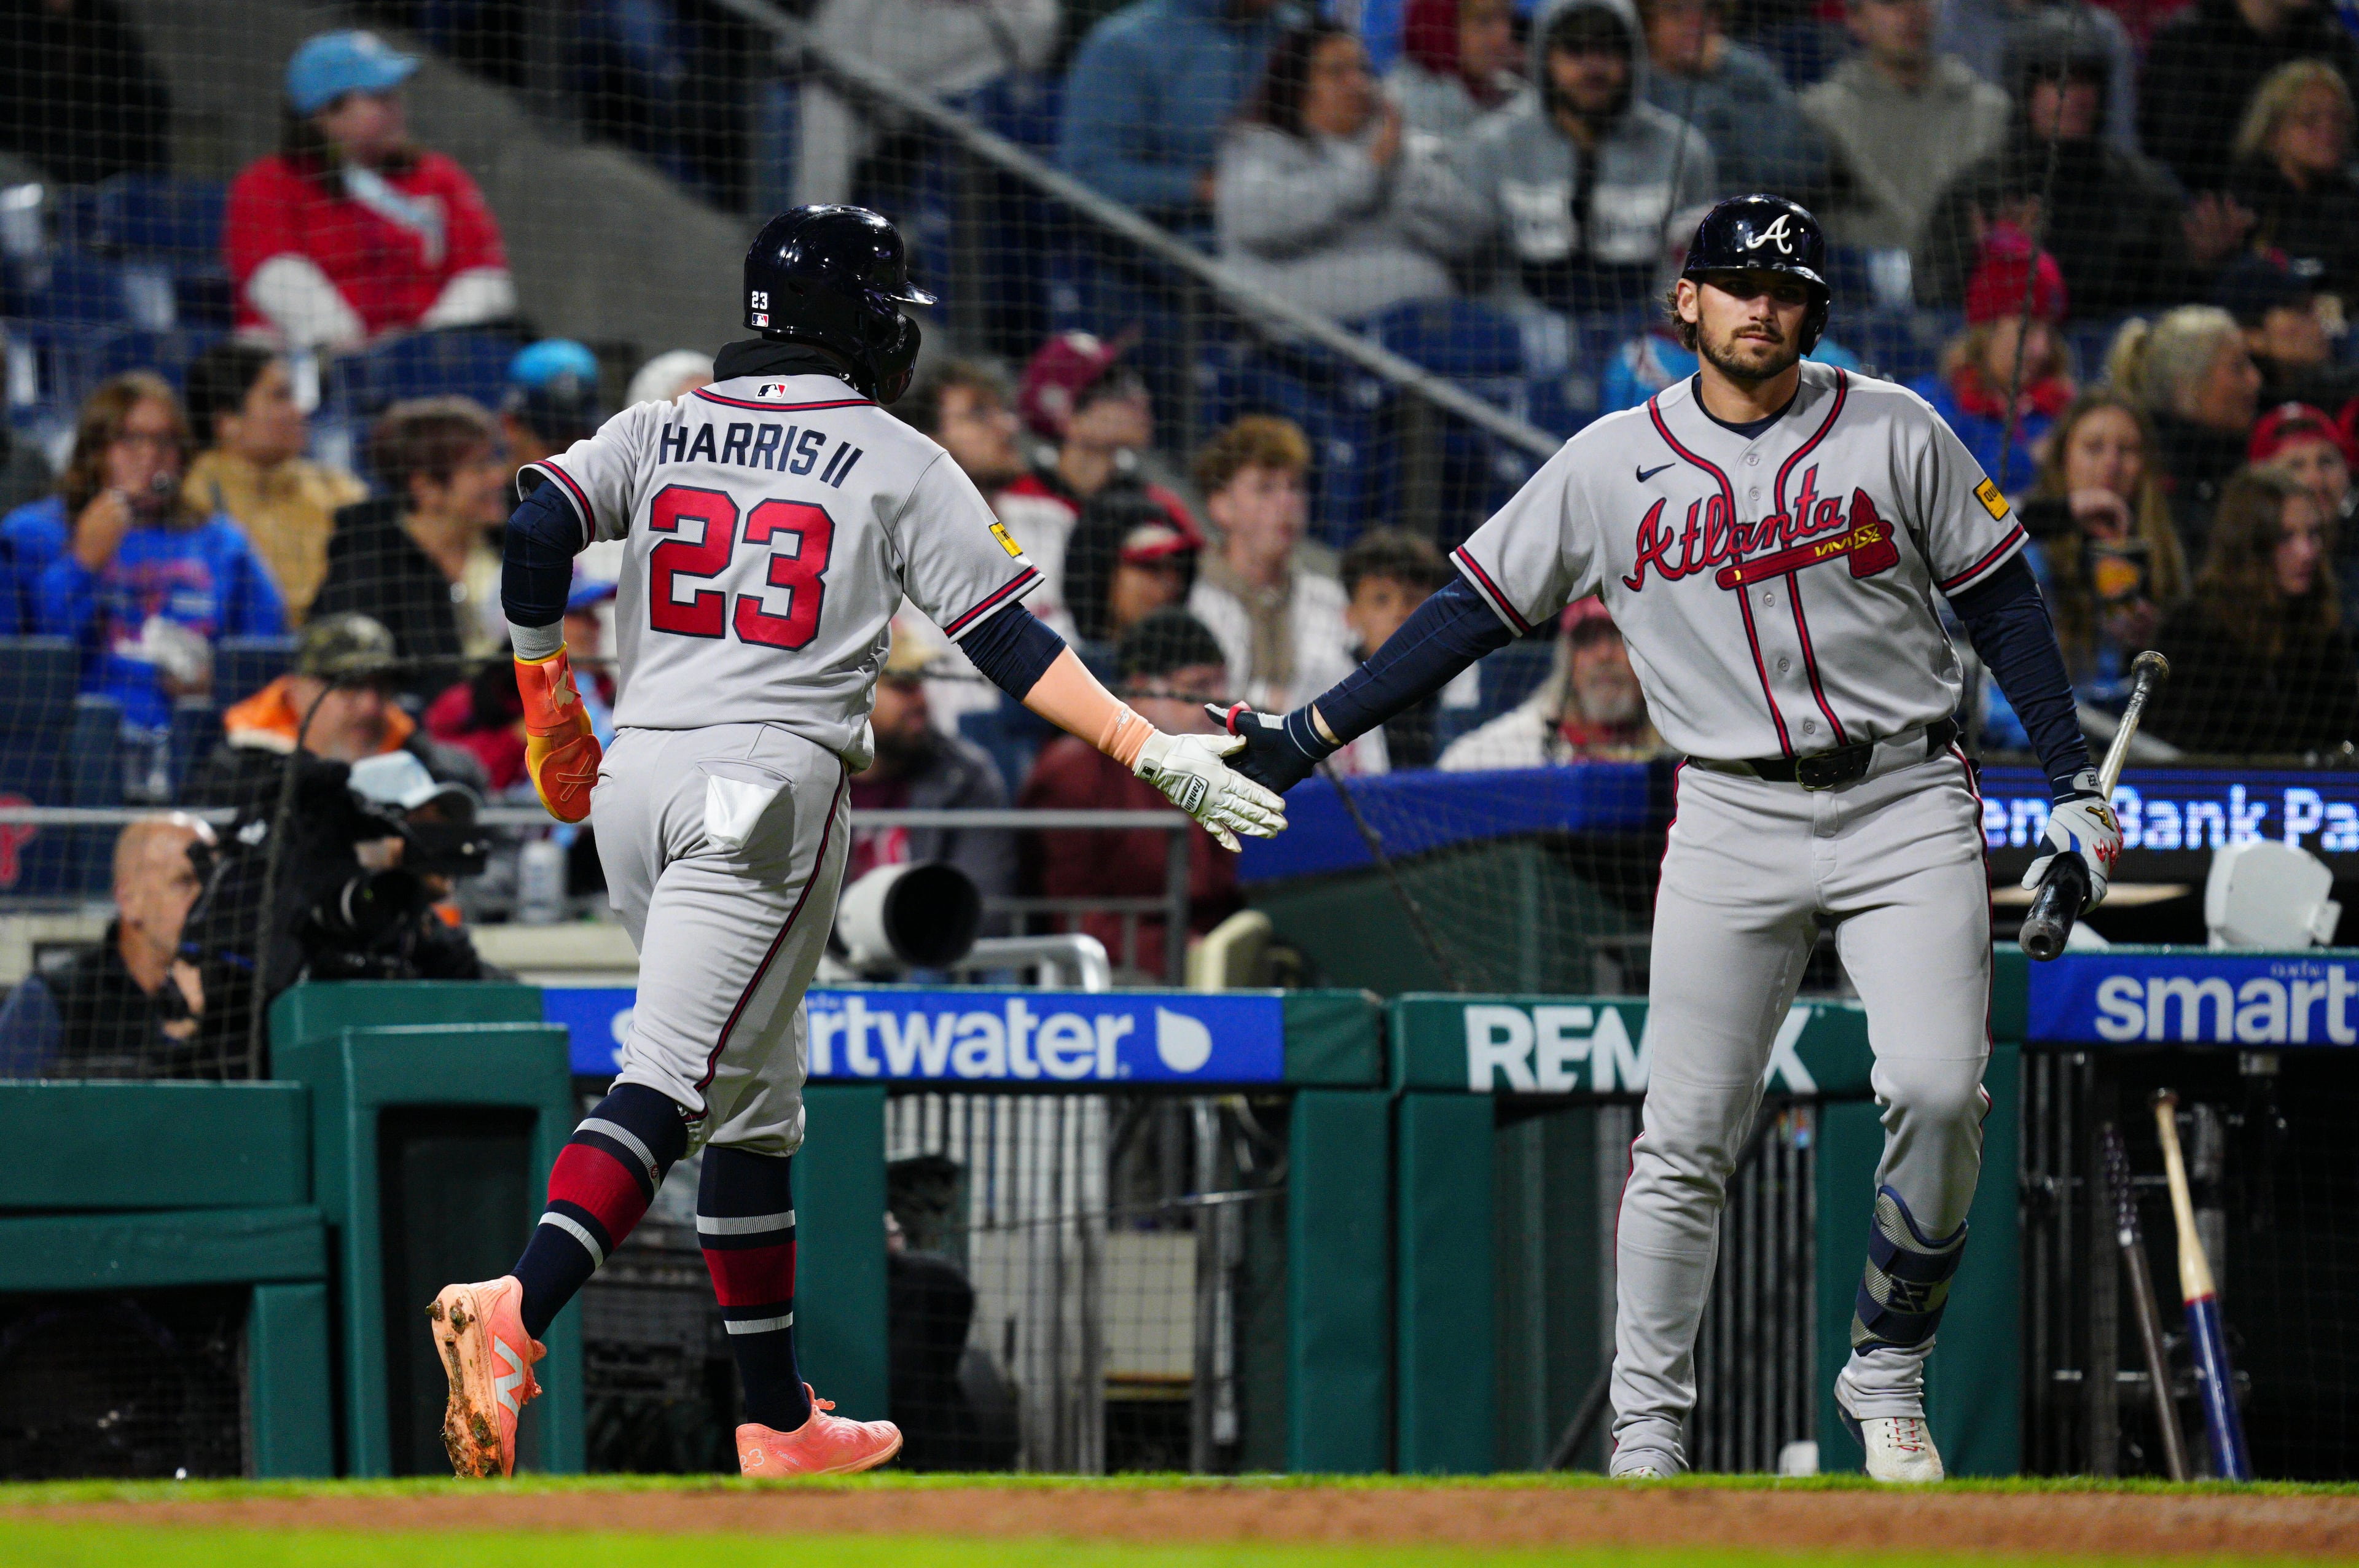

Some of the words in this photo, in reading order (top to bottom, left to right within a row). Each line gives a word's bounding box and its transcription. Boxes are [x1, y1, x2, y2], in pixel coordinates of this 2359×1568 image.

[1746, 214, 1793, 254] A
[751, 291, 769, 310] 23
[659, 423, 827, 475] HARRIS
[820, 441, 864, 489] II
[1622, 462, 1846, 592] Atlanta
[649, 483, 836, 652] 23
[2111, 784, 2269, 850] Bank
[740, 1448, 765, 1473] 23
